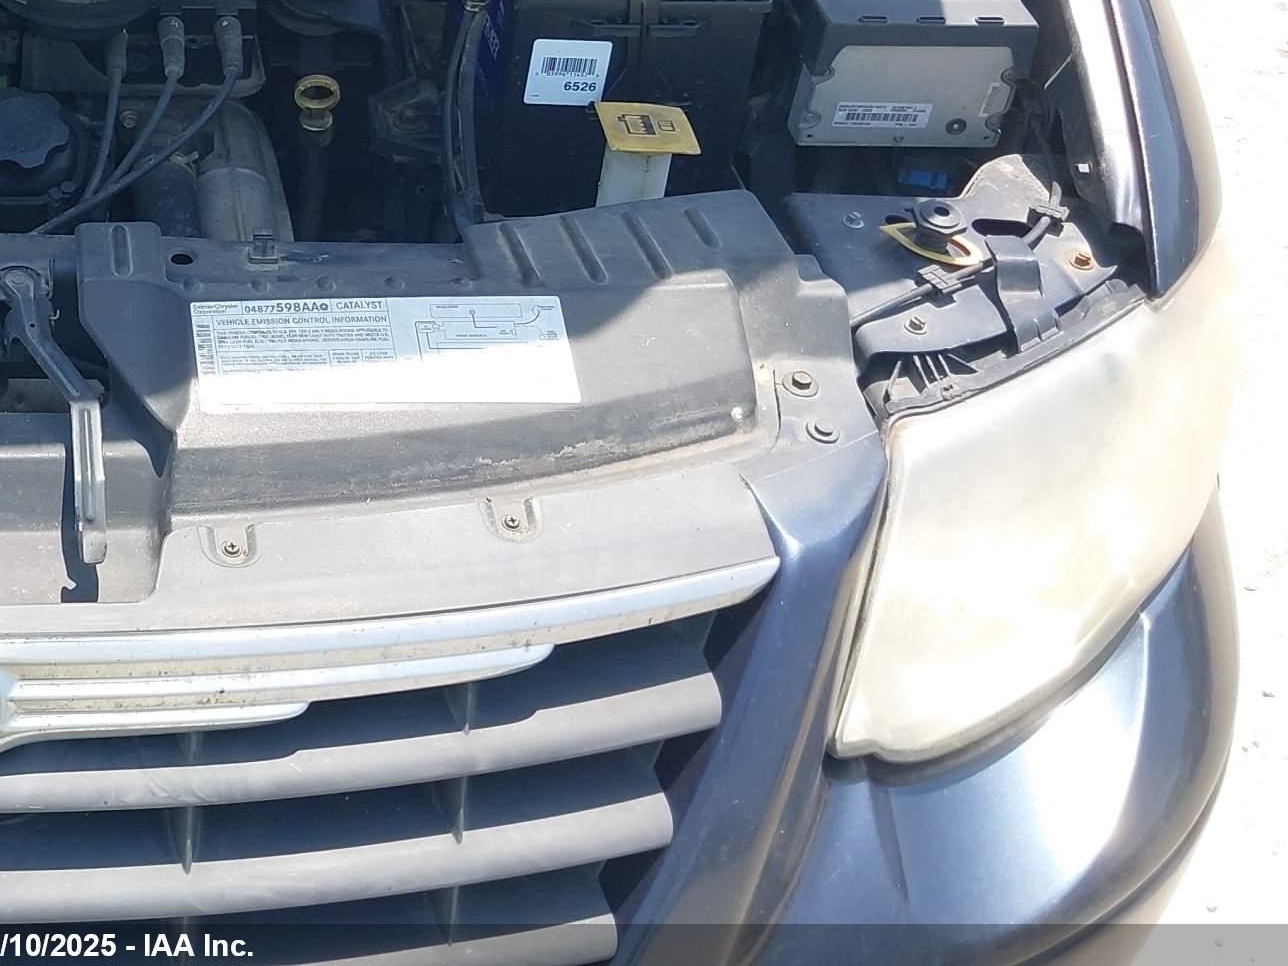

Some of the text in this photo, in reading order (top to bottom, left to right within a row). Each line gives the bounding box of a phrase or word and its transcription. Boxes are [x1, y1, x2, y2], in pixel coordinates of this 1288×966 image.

[564, 81, 597, 92] 6526
[336, 300, 383, 310] CATALYST
[216, 315, 388, 326] VEHICLE EMISSION CONTROL INFORMATION
